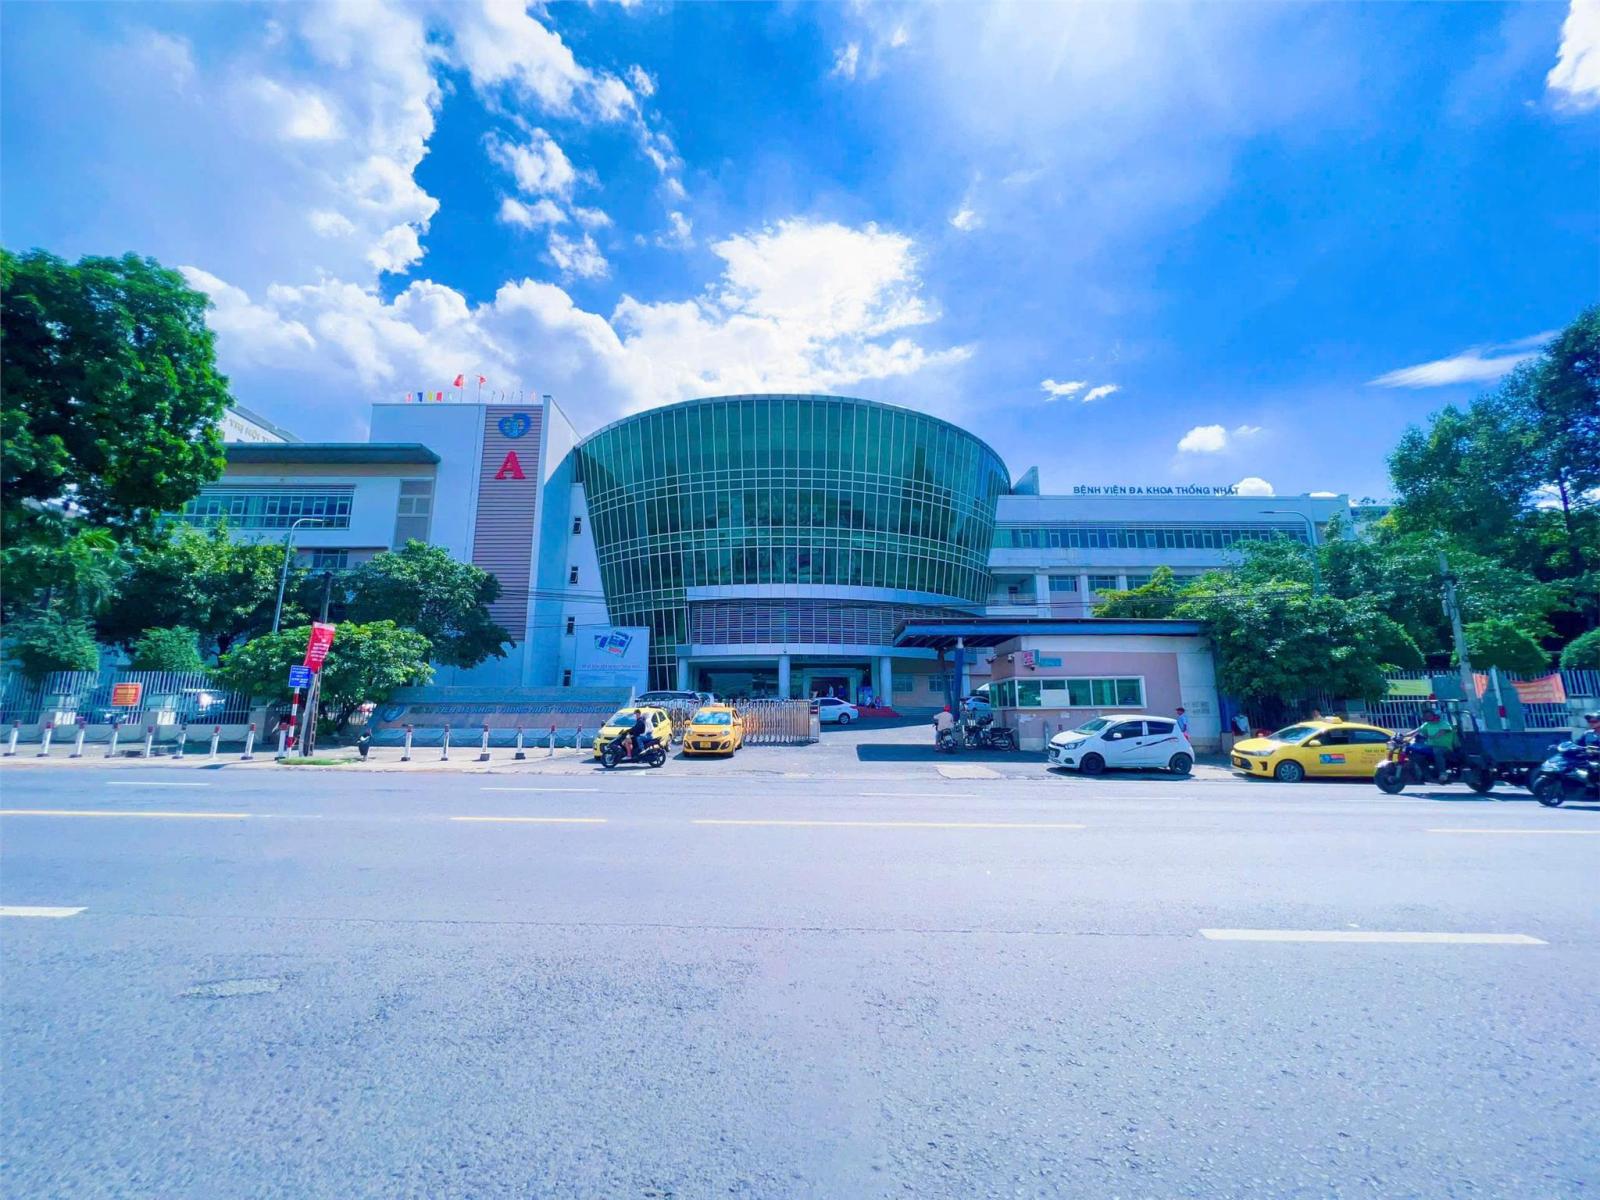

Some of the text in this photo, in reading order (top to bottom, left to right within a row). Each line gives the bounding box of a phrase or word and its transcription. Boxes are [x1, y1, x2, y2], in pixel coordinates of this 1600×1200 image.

[495, 450, 526, 480] A
[1073, 483, 1240, 496] BỆNH VIỆN ĐA KHOA THỐNG NHẤT
